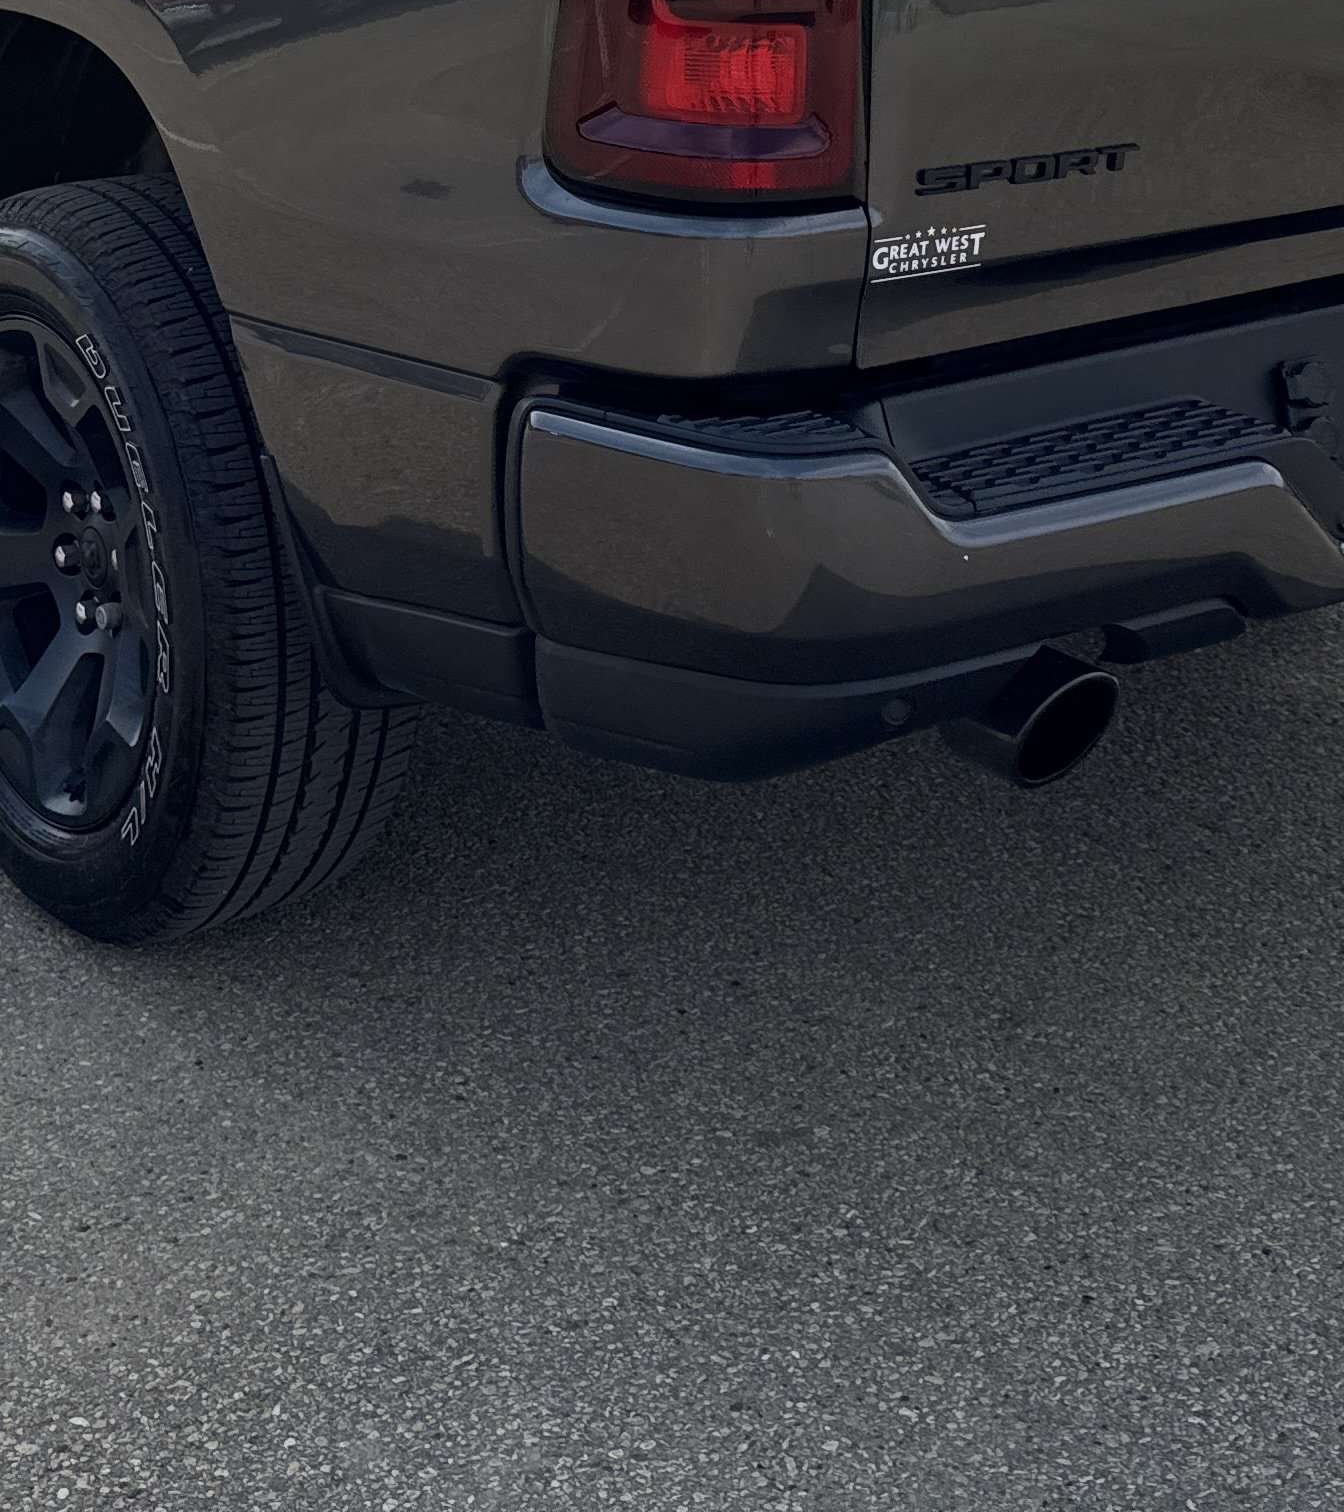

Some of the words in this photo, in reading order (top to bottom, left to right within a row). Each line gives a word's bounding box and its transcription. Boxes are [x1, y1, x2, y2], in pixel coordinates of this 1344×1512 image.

[914, 142, 1141, 197] SPORT
[872, 239, 929, 271] GREAT
[935, 232, 986, 256] WEST
[888, 252, 968, 275] CHRYSLER
[76, 334, 170, 694] DUELER
